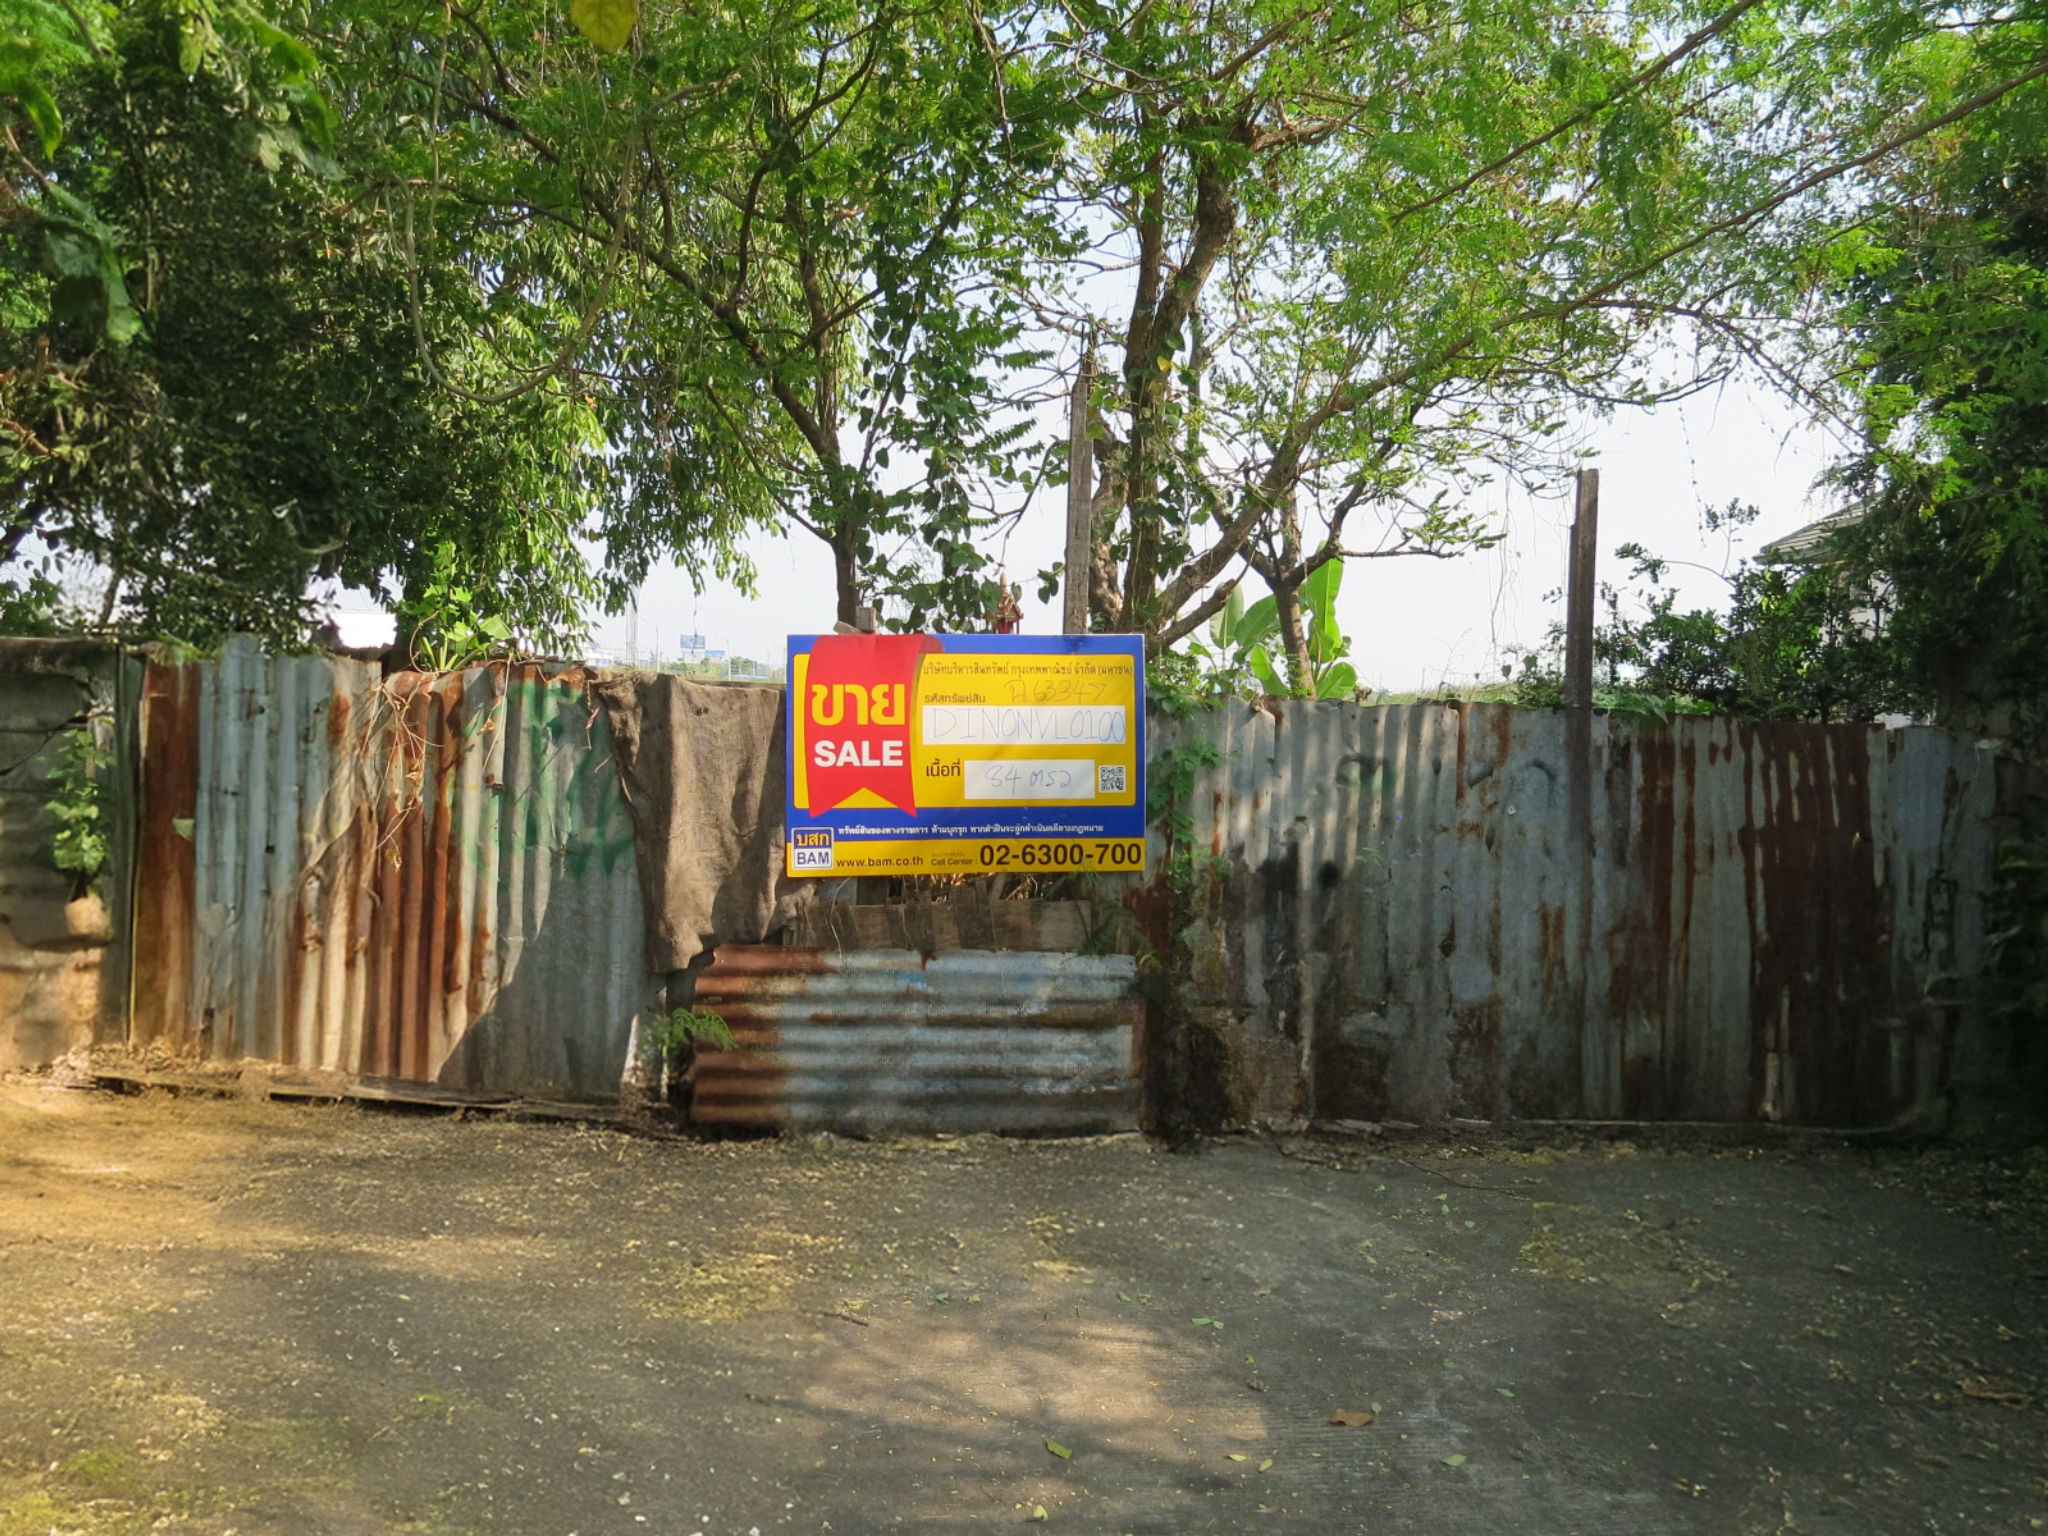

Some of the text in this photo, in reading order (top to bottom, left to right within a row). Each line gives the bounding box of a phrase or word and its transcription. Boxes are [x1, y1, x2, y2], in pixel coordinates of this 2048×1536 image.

[1074, 661, 1096, 675] จำกัด
[811, 683, 906, 726] ขาย
[924, 692, 986, 704] รหัสทรัพย์สิน
[814, 740, 903, 767] SALE
[926, 758, 961, 777] เนื้อที่
[796, 832, 830, 847] บสก
[797, 851, 830, 865] BAM
[836, 856, 924, 867] www.bam.co.th
[931, 858, 945, 866] Call
[980, 844, 1142, 866] 02-6300-700
